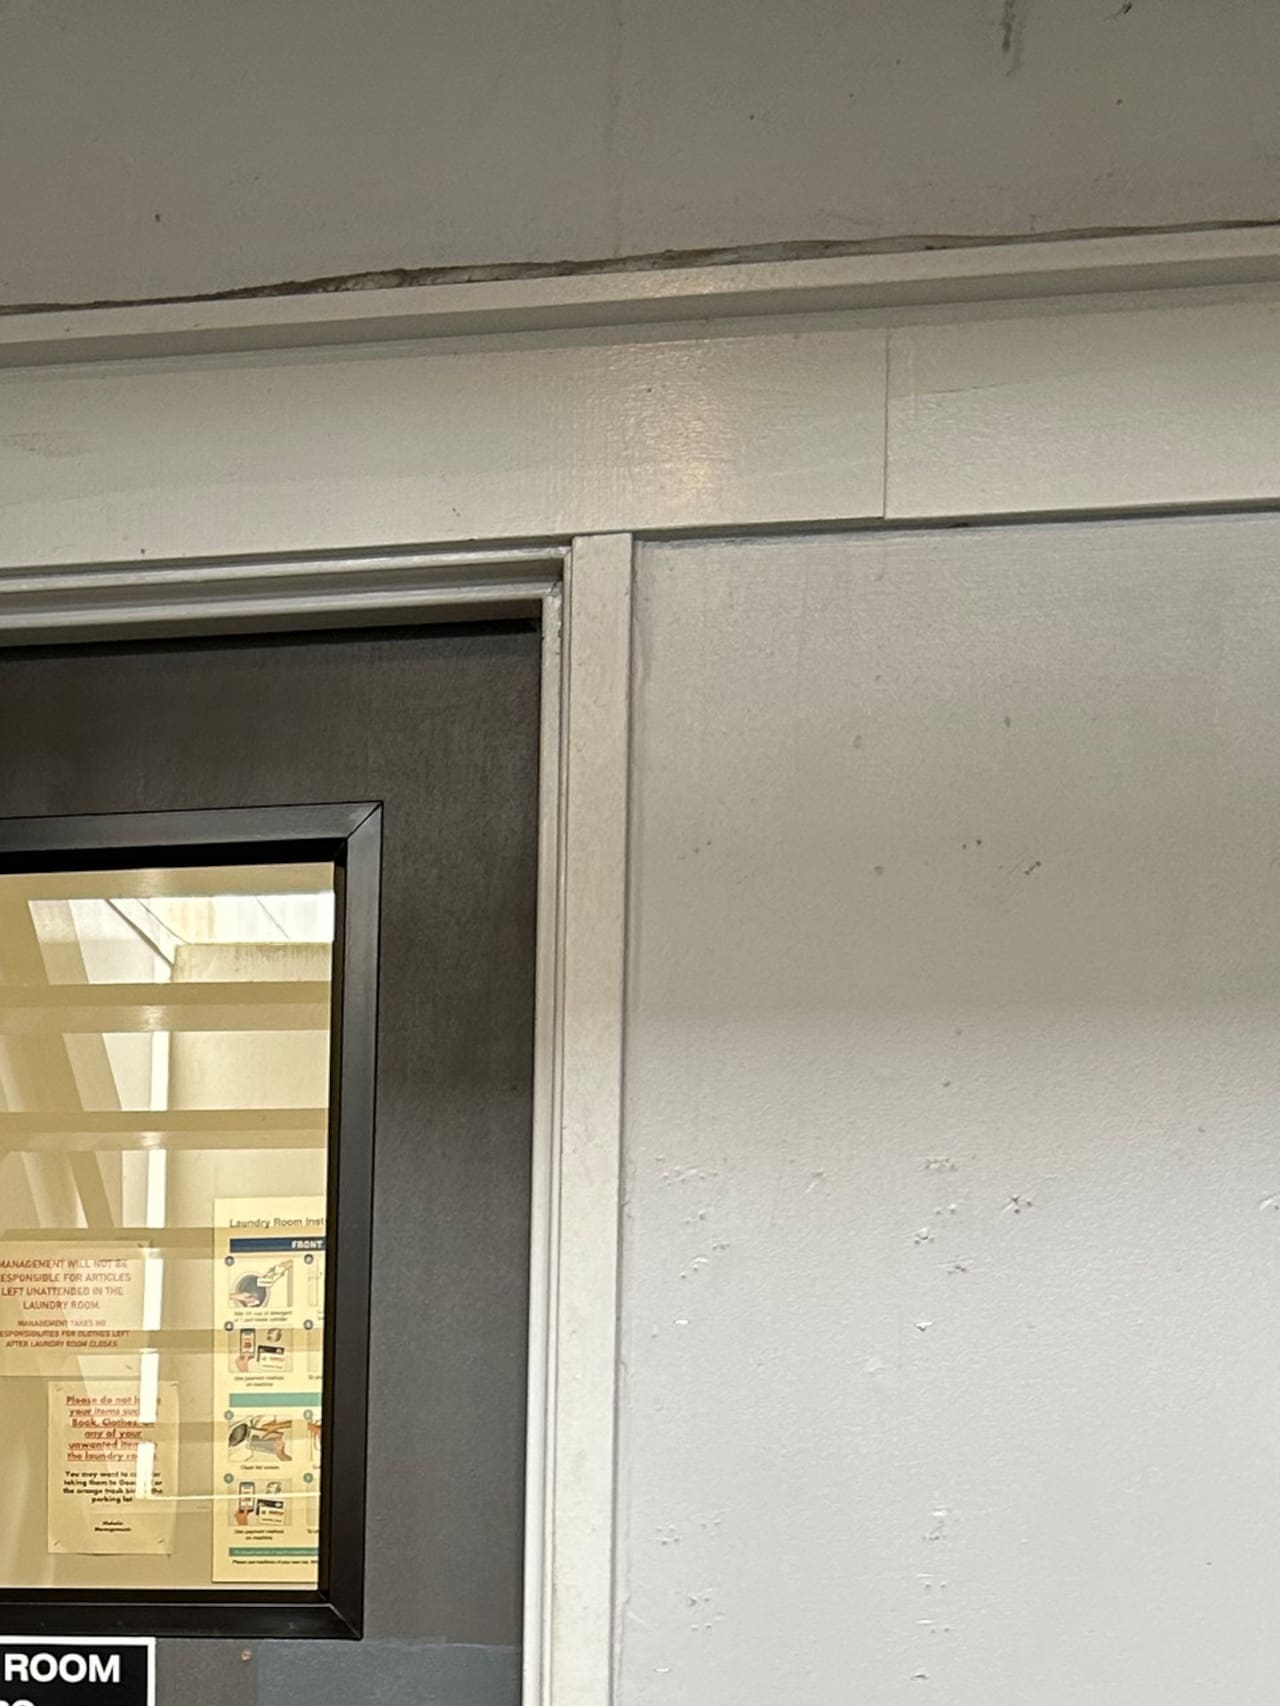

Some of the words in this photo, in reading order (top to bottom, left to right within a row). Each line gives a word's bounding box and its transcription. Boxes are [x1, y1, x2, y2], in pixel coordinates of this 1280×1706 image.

[230, 1218, 270, 1229] Laundry
[274, 1217, 303, 1227] Room
[67, 1259, 92, 1269] WILL
[63, 1273, 84, 1282] FOR
[86, 1273, 132, 1282] ARTICLES
[1, 1287, 24, 1296] LEFT
[26, 1287, 90, 1296] UNATTENDED
[93, 1287, 103, 1296] IN
[105, 1286, 124, 1295] THE
[23, 1301, 68, 1310] LAUNDRY
[17, 1319, 67, 1327] MANAGEMENT
[66, 1396, 97, 1404] Please
[101, 1395, 113, 1403] do
[69, 1409, 92, 1417] your
[84, 1431, 102, 1439] any
[106, 1428, 116, 1438] of
[119, 1431, 143, 1439] your
[68, 1439, 118, 1448] unwanted
[67, 1452, 83, 1460] the
[85, 1451, 125, 1460] laundry
[5, 1653, 120, 1683] ROOM
